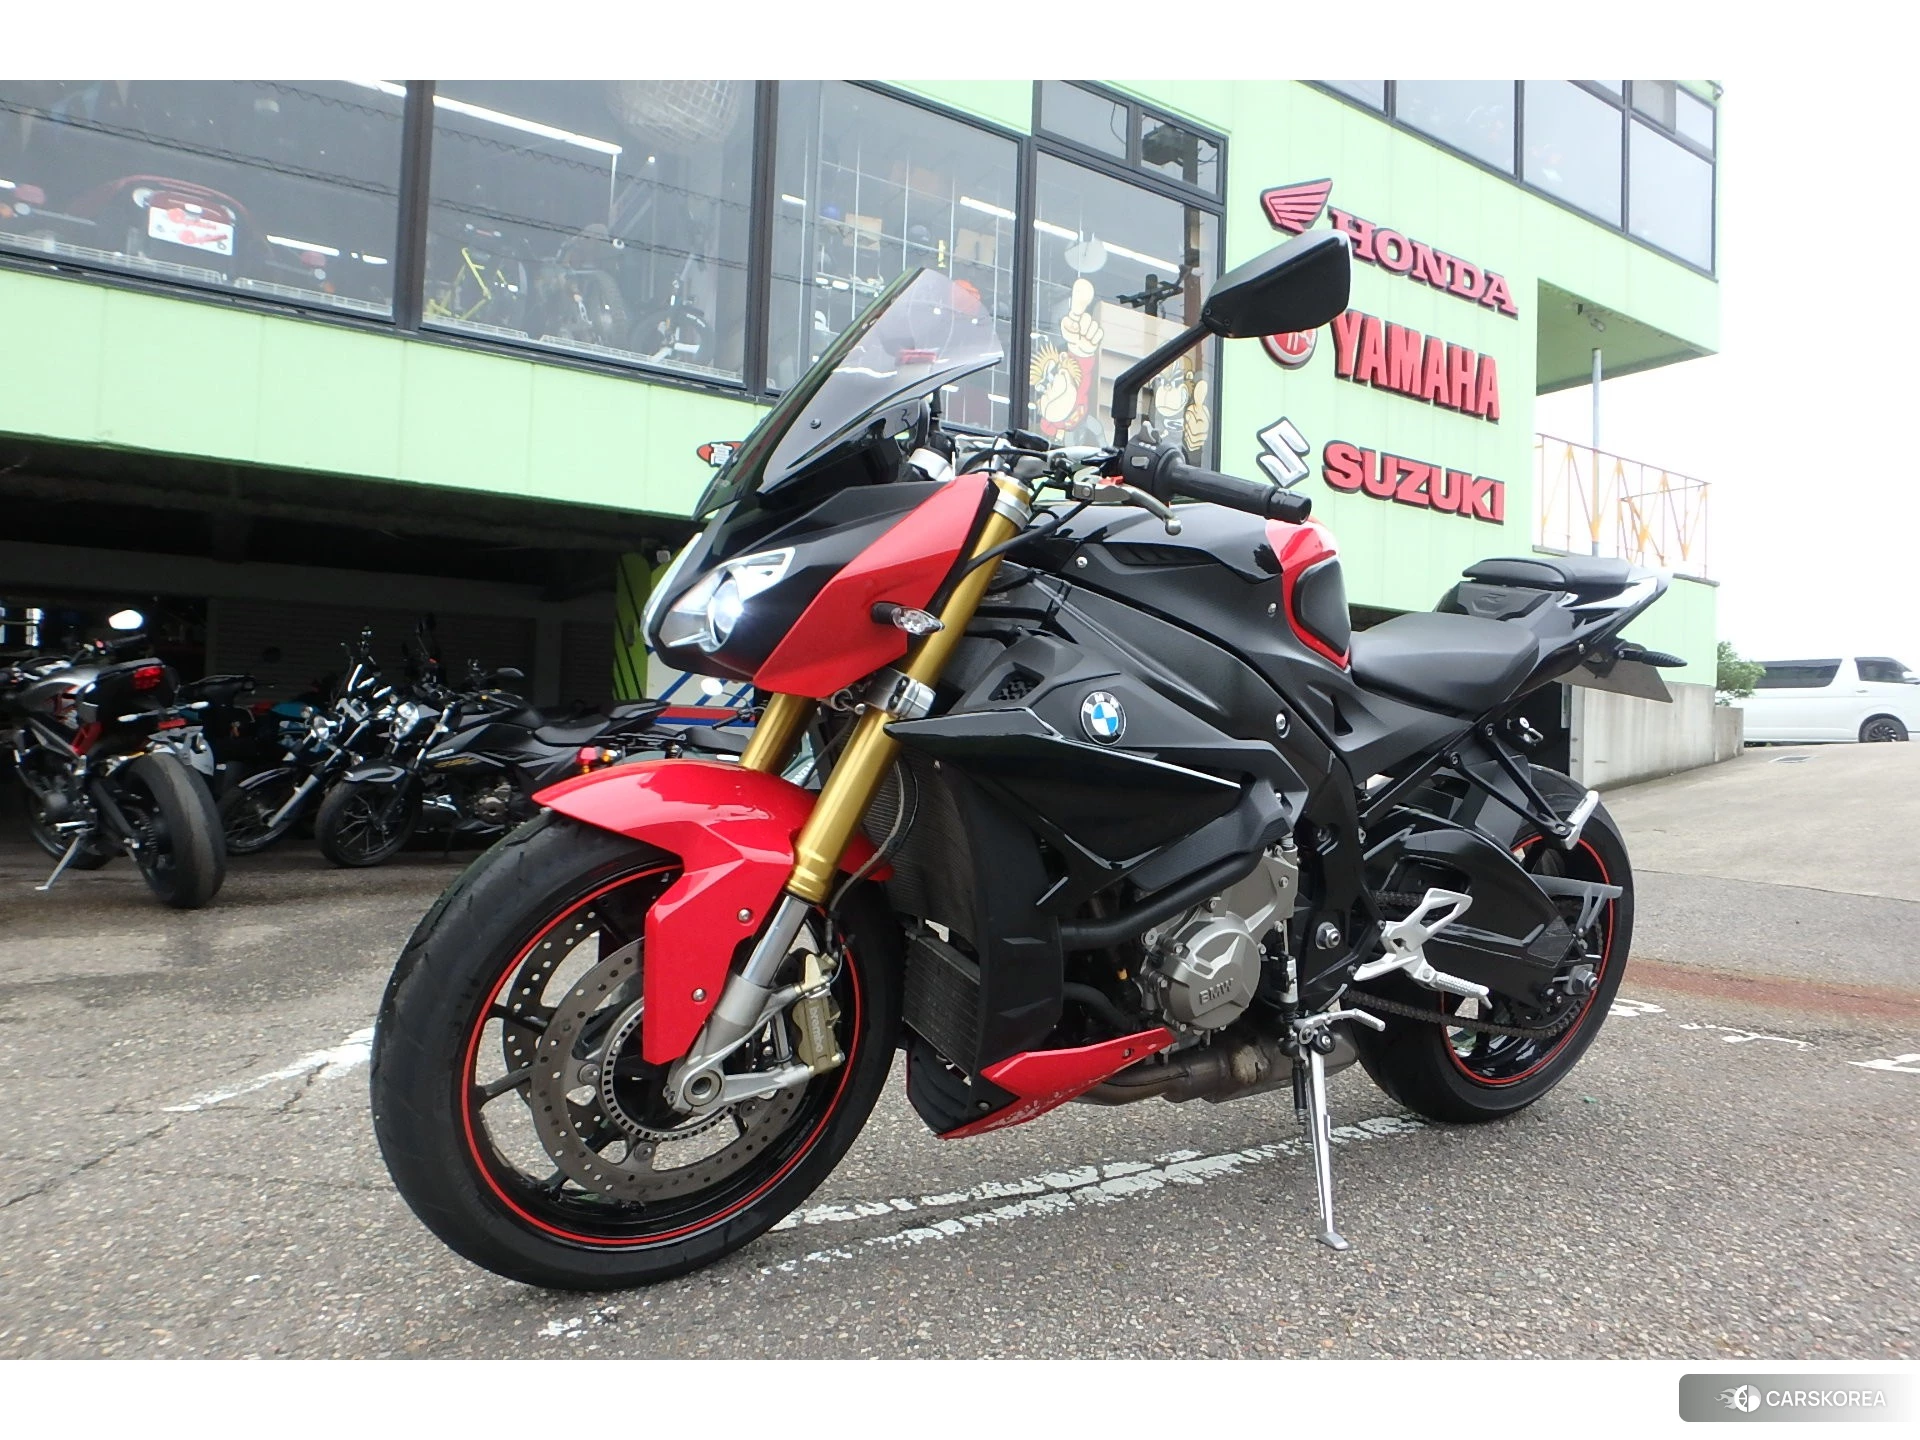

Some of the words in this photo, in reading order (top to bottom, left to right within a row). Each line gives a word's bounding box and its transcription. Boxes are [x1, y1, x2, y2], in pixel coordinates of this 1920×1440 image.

[1327, 206, 1518, 319] HONDA
[1330, 309, 1499, 424] YAMAHA
[1322, 439, 1505, 525] SUZUKI
[809, 1006, 825, 1053] brembo
[1199, 977, 1234, 1005] BMW
